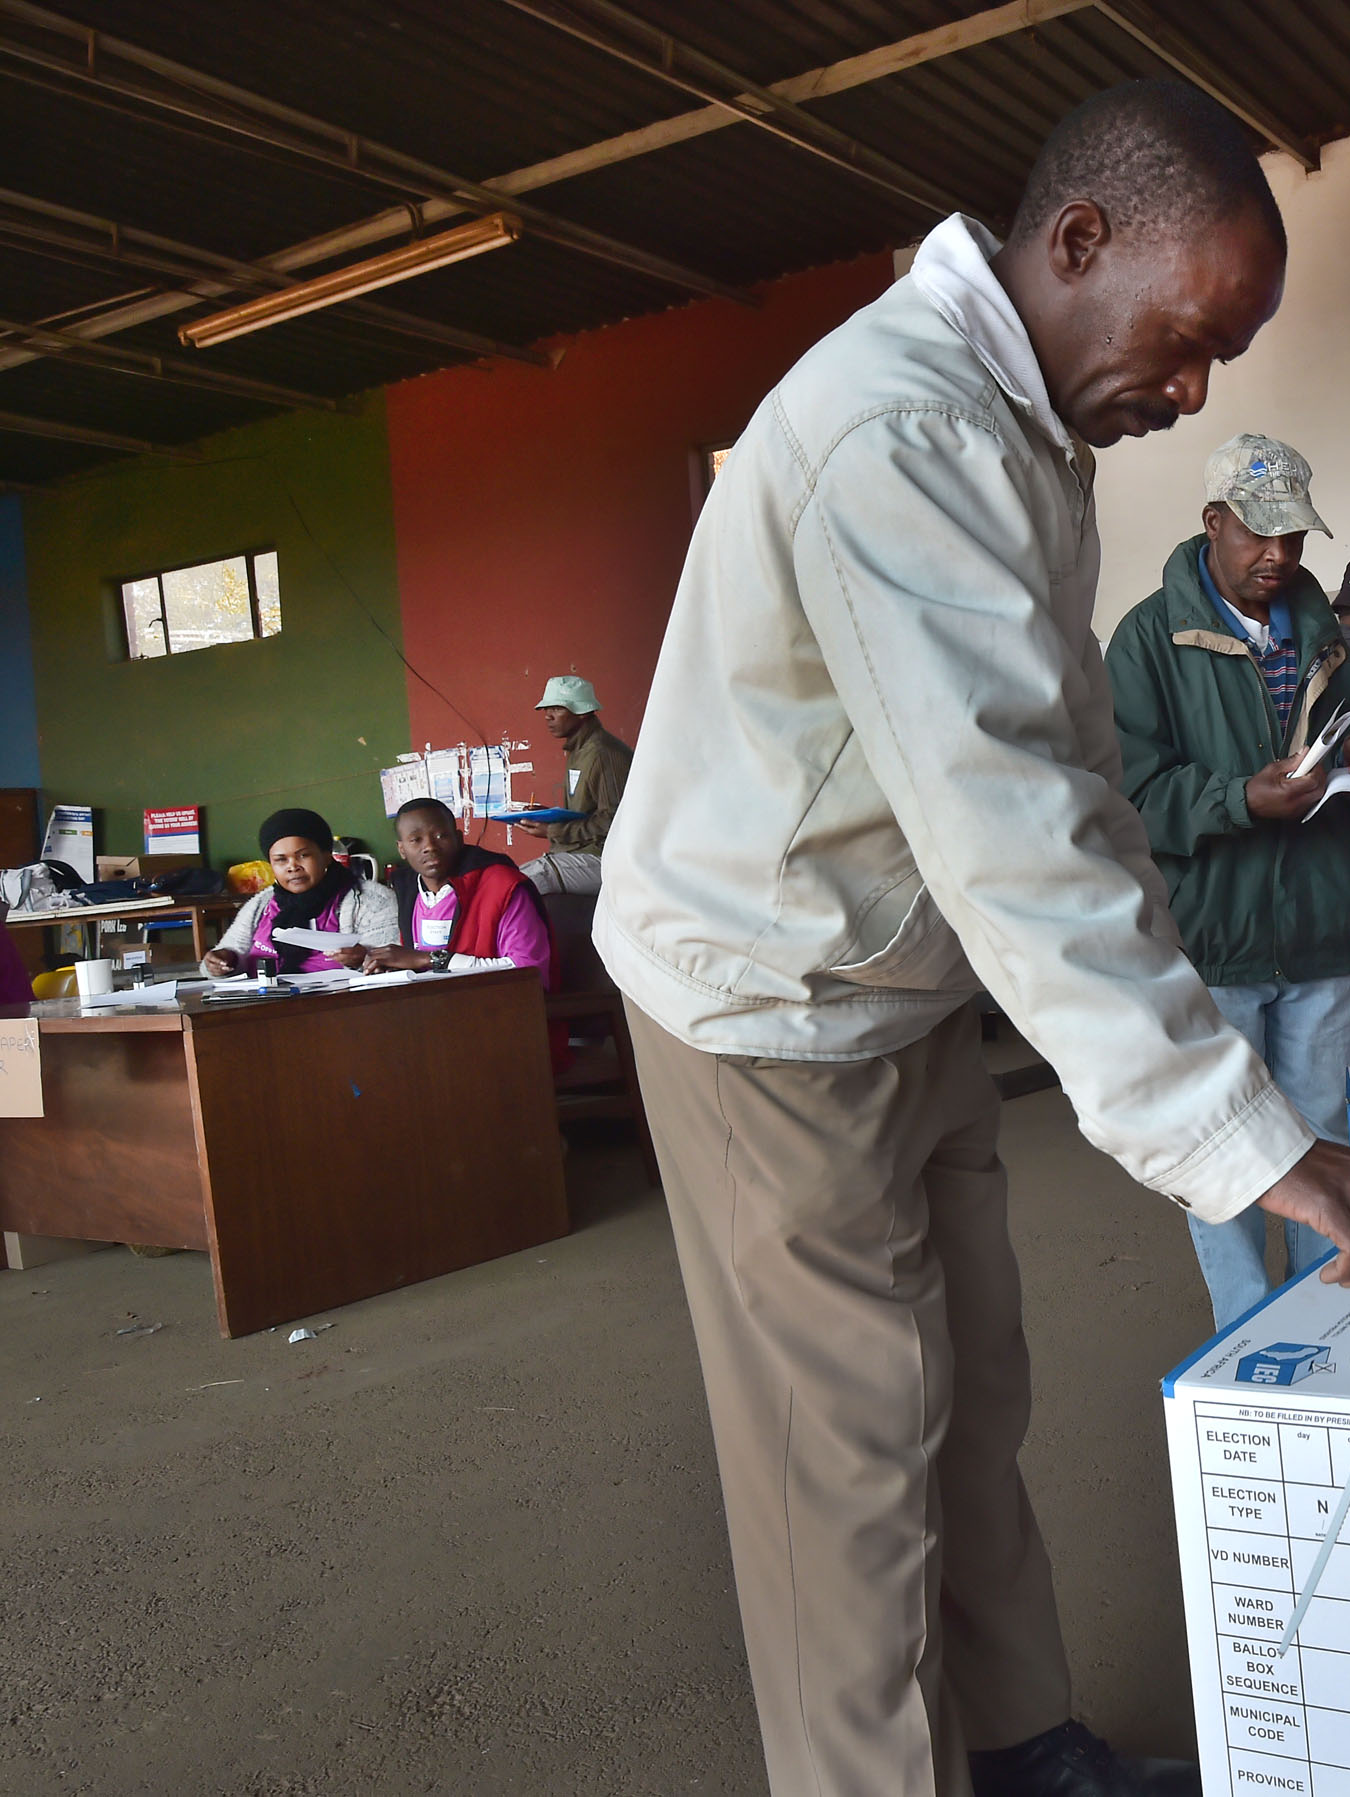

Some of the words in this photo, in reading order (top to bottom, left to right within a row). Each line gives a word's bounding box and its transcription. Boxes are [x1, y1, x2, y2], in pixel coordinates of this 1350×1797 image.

[101, 920, 116, 932] PORK
[1225, 1340, 1251, 1358] SOUTH
[1201, 1357, 1229, 1378] AFRICA
[1251, 1363, 1281, 1384] IEC
[1254, 1410, 1264, 1418] TO
[1265, 1411, 1276, 1419] BE
[1277, 1413, 1303, 1421] FILLED
[1206, 1430, 1271, 1447] ELECTION
[1297, 1432, 1310, 1440] day
[1224, 1450, 1257, 1463] DATE
[1212, 1486, 1276, 1503] ELECTION
[1229, 1506, 1262, 1520] TYPE
[1317, 1500, 1328, 1514] N
[1211, 1549, 1228, 1561] VD
[1233, 1552, 1290, 1569] NUMBER
[1234, 1596, 1273, 1612] WARD
[1228, 1613, 1284, 1631] NUMBER
[1233, 1642, 1280, 1658] BALLO
[1247, 1662, 1274, 1676] BOX
[1226, 1675, 1298, 1696] SEQUENCE
[1230, 1706, 1301, 1728] MUNICIPAL
[1248, 1726, 1285, 1742] CODE
[1238, 1770, 1304, 1792] PROVINCE
